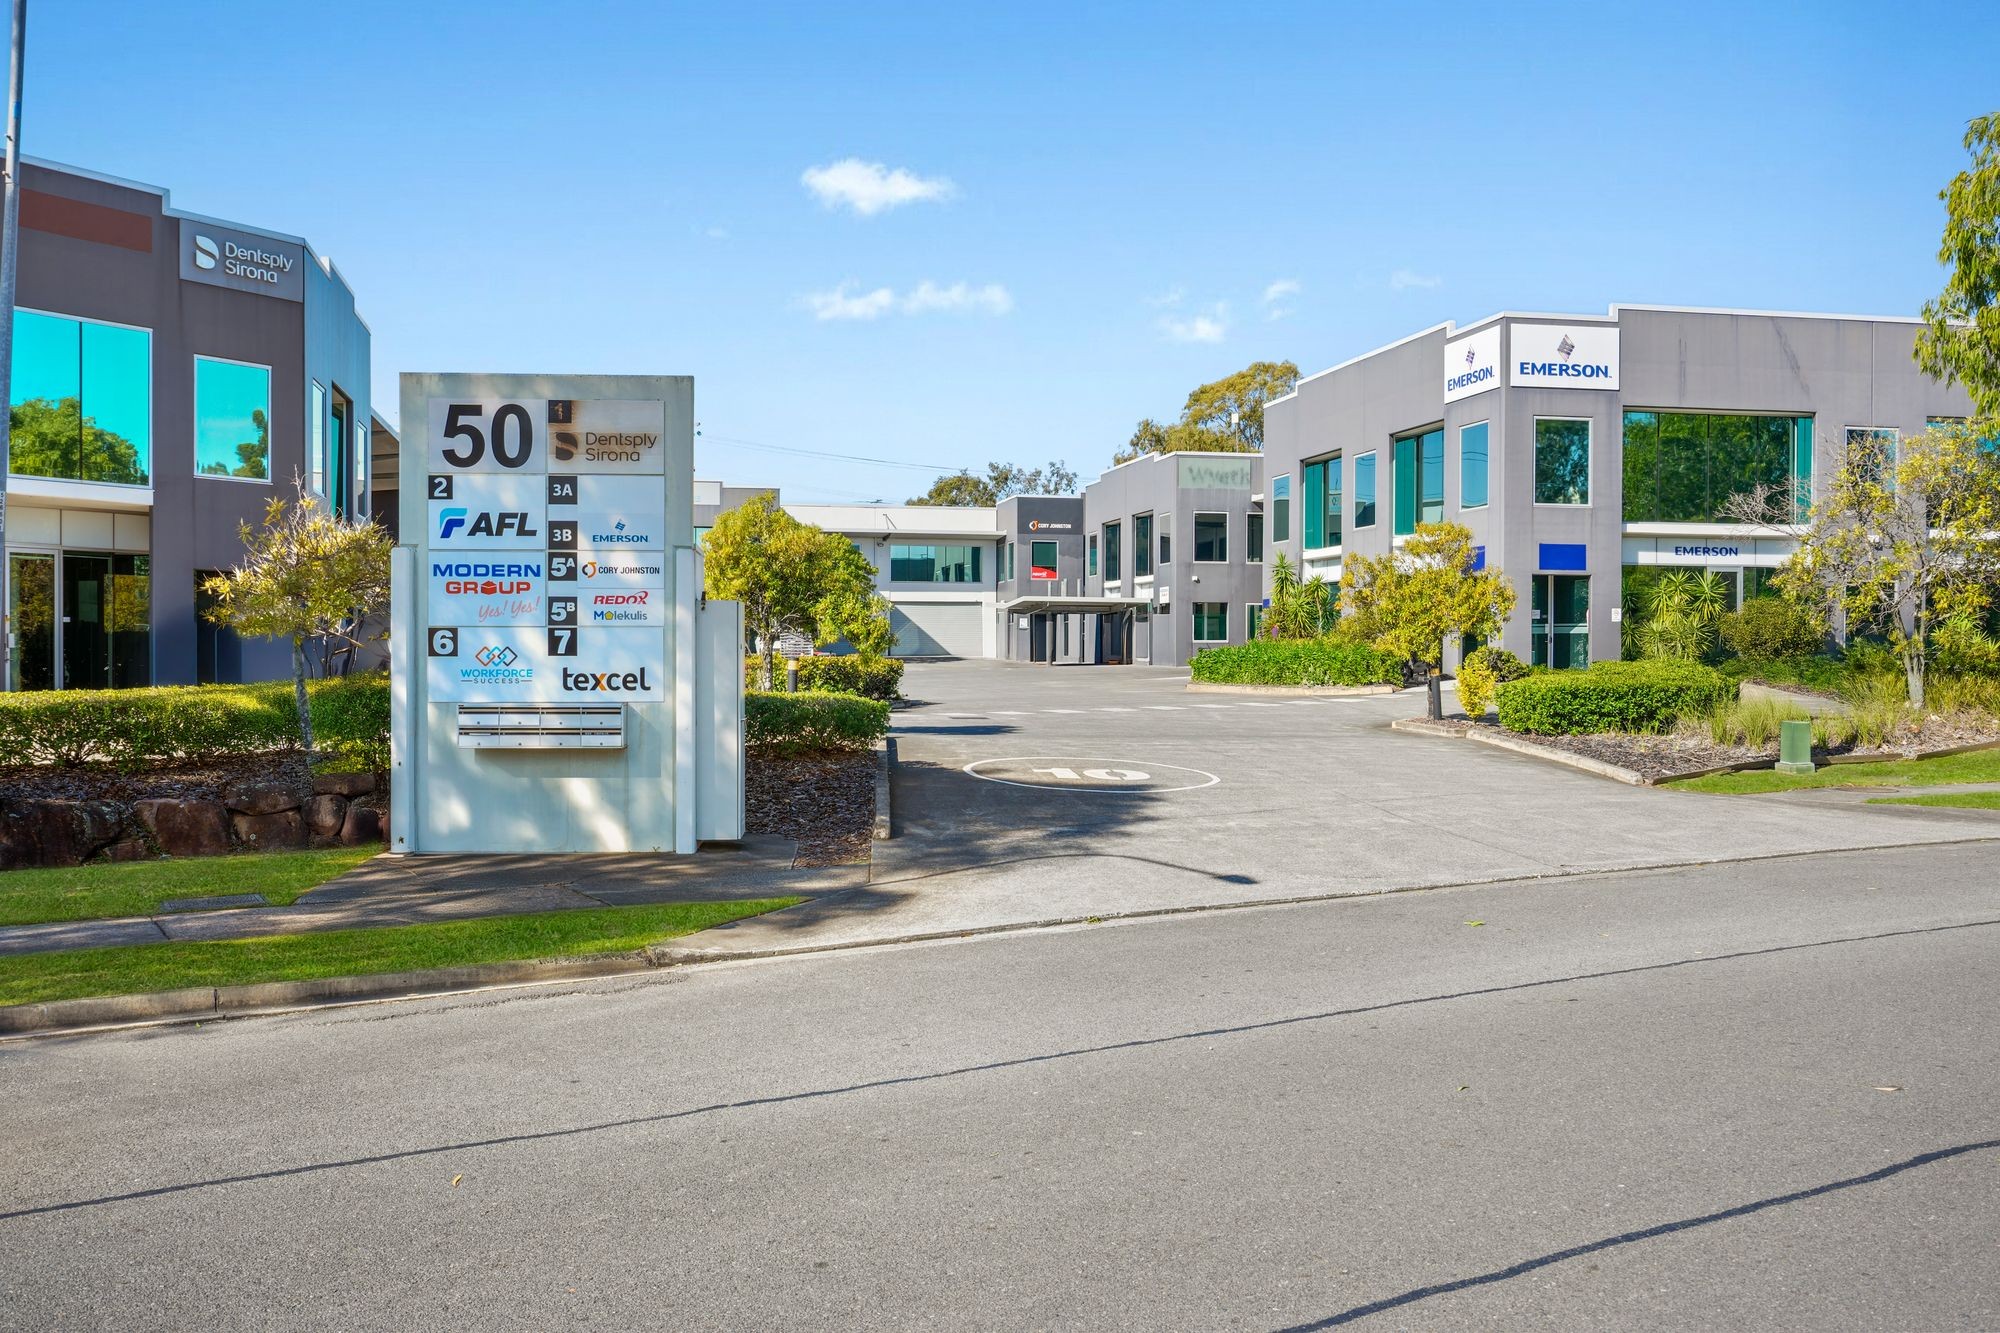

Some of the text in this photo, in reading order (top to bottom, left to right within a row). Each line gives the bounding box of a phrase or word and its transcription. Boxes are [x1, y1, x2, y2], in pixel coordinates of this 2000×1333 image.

[225, 241, 293, 272] Dentsply
[225, 259, 278, 283] Sirona
[1447, 365, 1493, 392] EMERSON
[1519, 361, 1609, 379] EMERSON
[441, 403, 533, 468] 50
[585, 432, 657, 449] Dentsply
[585, 447, 640, 462] Sirona
[433, 477, 448, 497] 2
[552, 483, 573, 496] 3A
[467, 512, 537, 537] AFL
[552, 529, 572, 542] 3B
[592, 534, 648, 543] EMERSON
[1675, 546, 1738, 557] EMERSON
[433, 563, 541, 577] MODERN
[550, 557, 576, 577] 5A
[598, 566, 660, 575] CORY JOHNSTON
[445, 580, 531, 595] GROUP
[593, 590, 649, 605] REDOX
[478, 595, 541, 623] Yes! Yes!
[550, 602, 576, 622] 5B
[593, 610, 648, 621] Molekulis
[432, 629, 454, 655] 6
[554, 629, 572, 655] 7
[461, 668, 533, 678] WORKFORCE
[562, 666, 651, 692] texcel
[1033, 767, 1151, 781] 10
